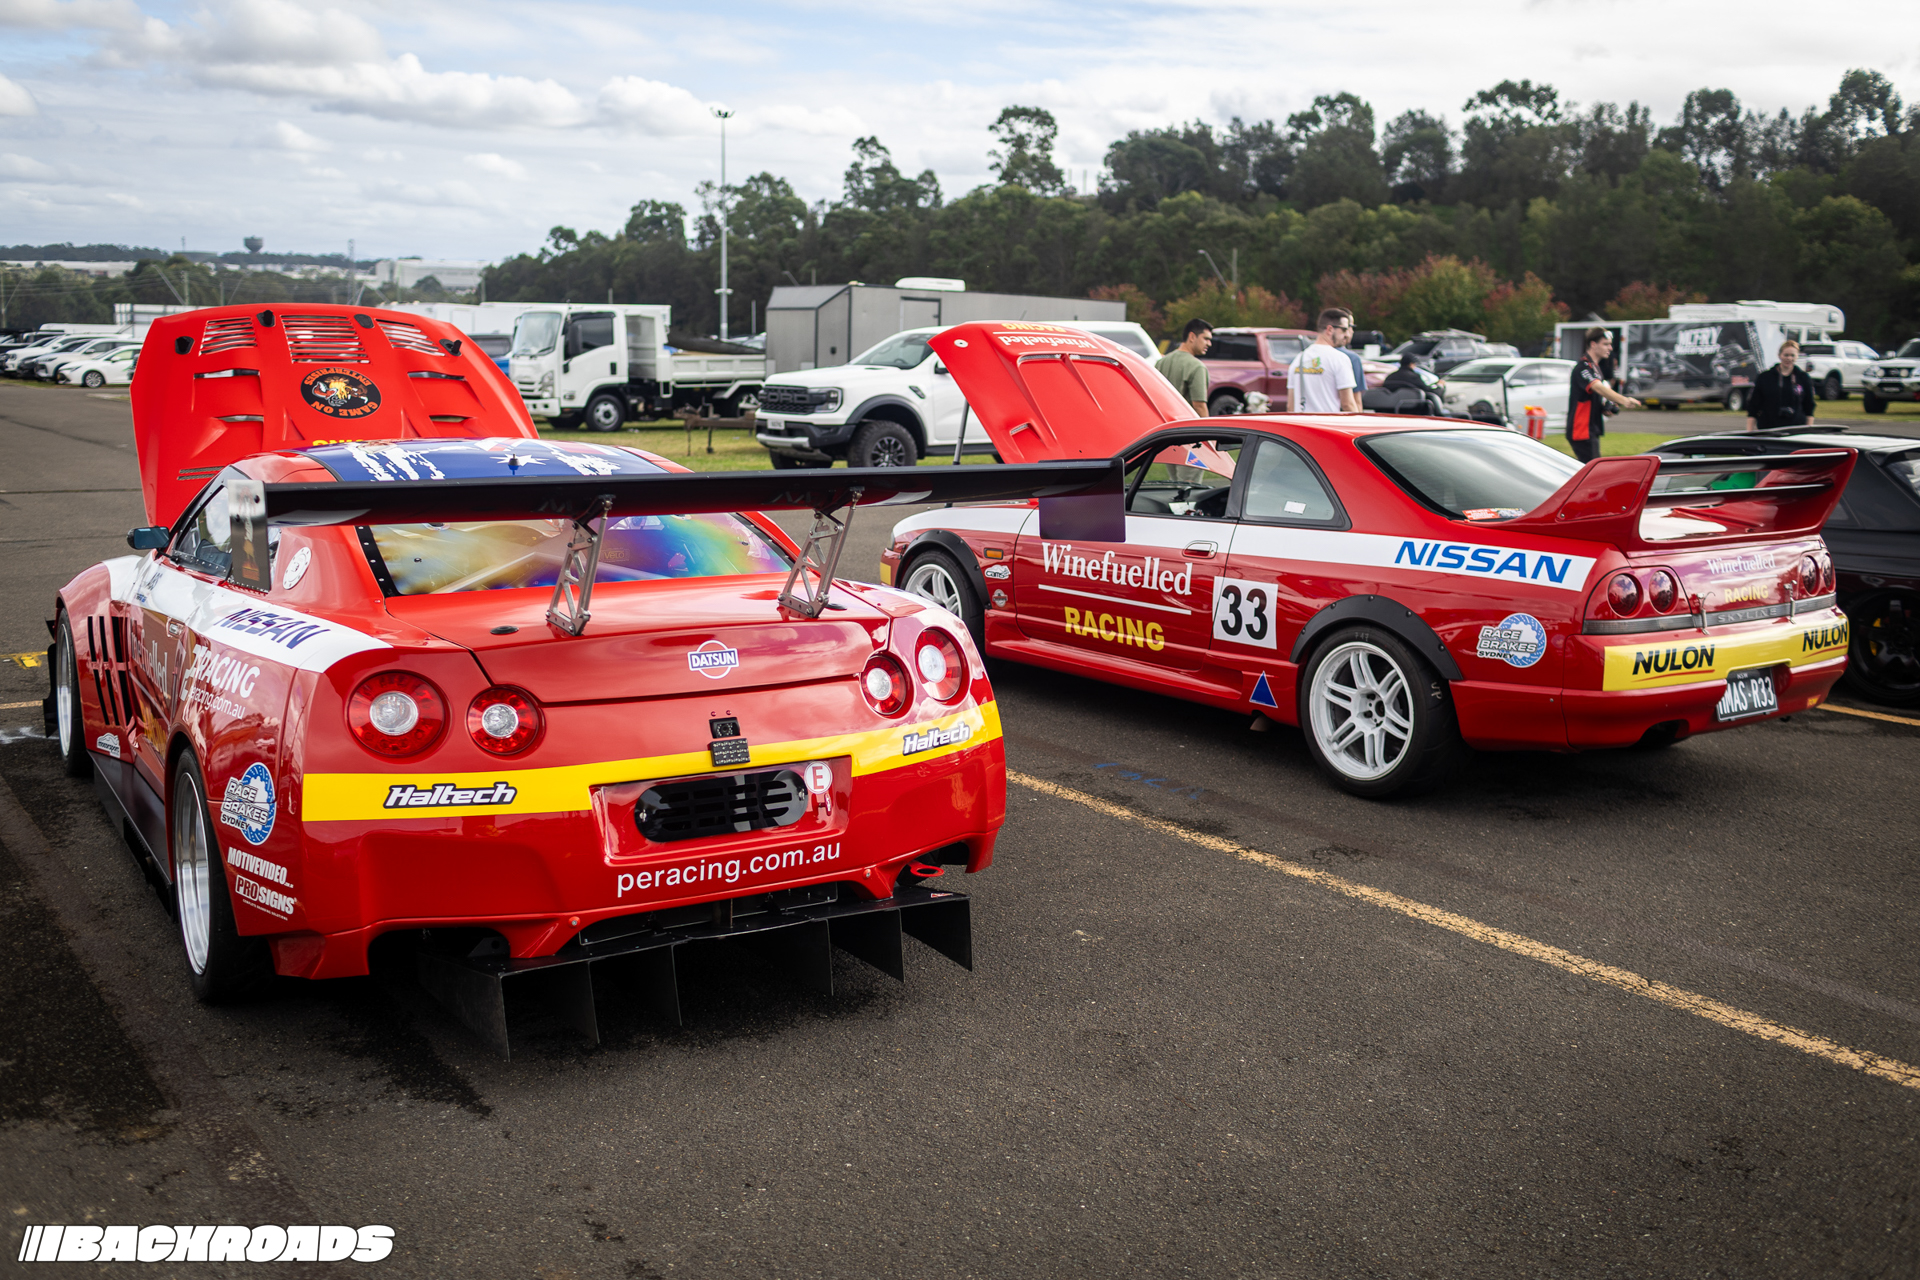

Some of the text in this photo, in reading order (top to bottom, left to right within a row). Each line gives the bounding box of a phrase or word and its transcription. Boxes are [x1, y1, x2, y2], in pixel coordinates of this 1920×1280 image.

[1001, 323, 1067, 333] RACING
[998, 336, 1098, 349] Winefuelled
[303, 367, 372, 387] ENTERPRISES
[311, 400, 379, 417] GAME ON
[1041, 542, 1193, 596] Winefuelled
[1395, 540, 1572, 584] NISSAN
[1707, 553, 1776, 575] Winefuelled
[1724, 584, 1769, 604] RACING
[1220, 584, 1268, 641] 33
[213, 608, 331, 650] NISSAN
[1064, 606, 1165, 652] RACING
[1482, 628, 1521, 640] RACE
[1802, 621, 1848, 652] NULON
[1478, 651, 1515, 659] SYDNEY
[1480, 640, 1537, 653] BRAKES
[690, 650, 736, 668] DATSUN
[1632, 644, 1715, 675] NULON
[903, 723, 970, 756] Haltech
[812, 764, 824, 790] E
[227, 781, 257, 802] RACE
[385, 783, 516, 807] Haltech
[221, 814, 250, 831] SYDNEY
[222, 799, 269, 823] BRAKES
[616, 842, 841, 898] peracing.com.au
